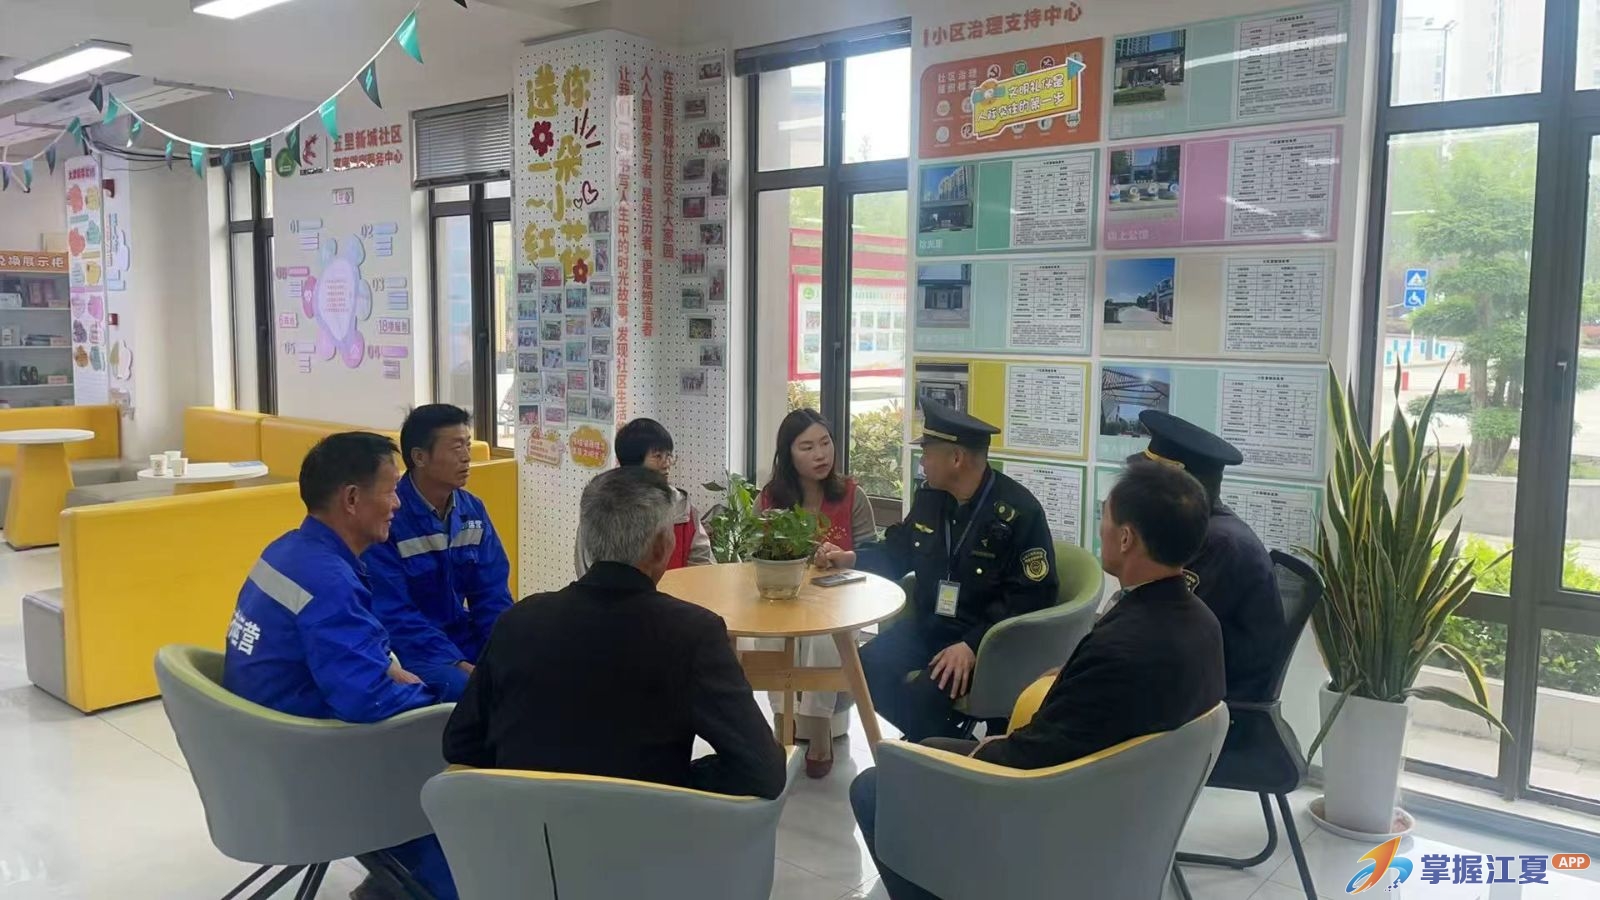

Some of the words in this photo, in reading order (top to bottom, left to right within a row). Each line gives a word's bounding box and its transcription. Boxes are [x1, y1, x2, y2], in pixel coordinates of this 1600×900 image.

[933, 2, 1082, 45] 小区治理支持中心
[526, 64, 591, 119] 送你
[938, 67, 977, 83] 社区治理
[333, 124, 402, 152] 五里新城社区
[528, 134, 583, 185] 一朵
